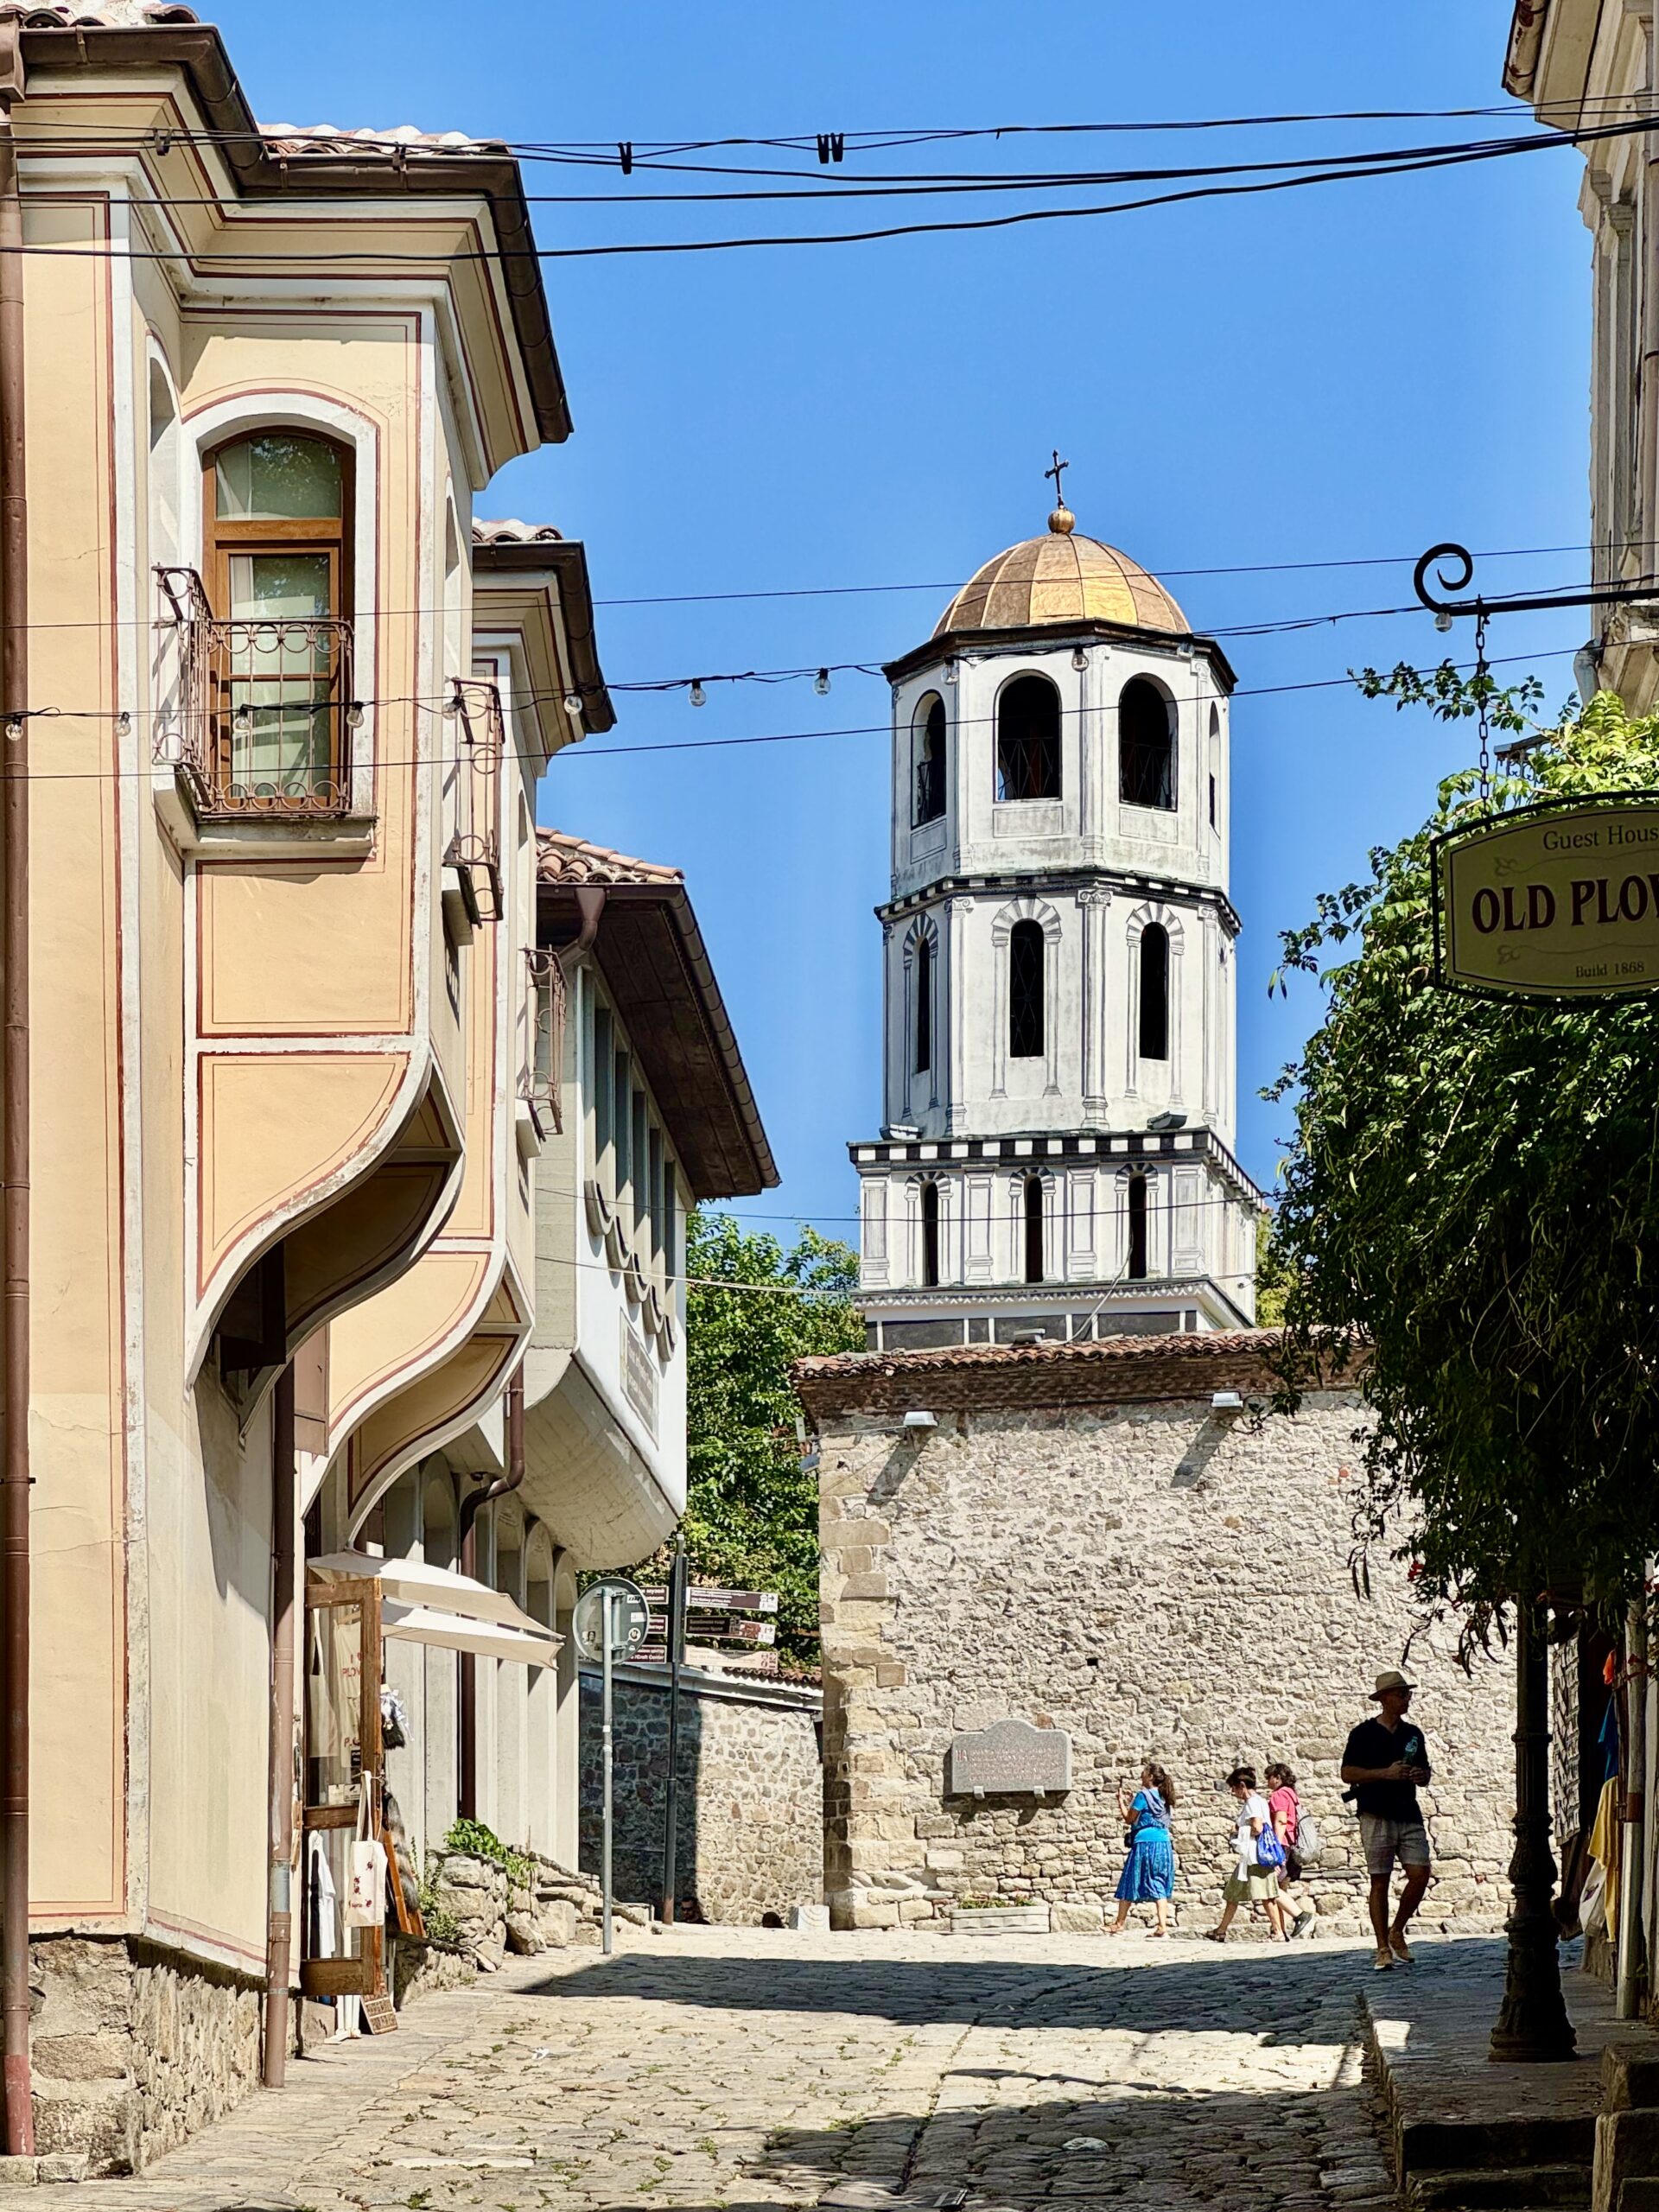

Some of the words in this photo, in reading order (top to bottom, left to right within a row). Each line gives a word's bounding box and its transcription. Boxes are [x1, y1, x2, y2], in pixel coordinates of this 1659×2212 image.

[1543, 830, 1599, 850] Guest
[1472, 884, 1555, 933] OLD
[1575, 963, 1607, 978] Build
[1614, 961, 1645, 976] 1868
